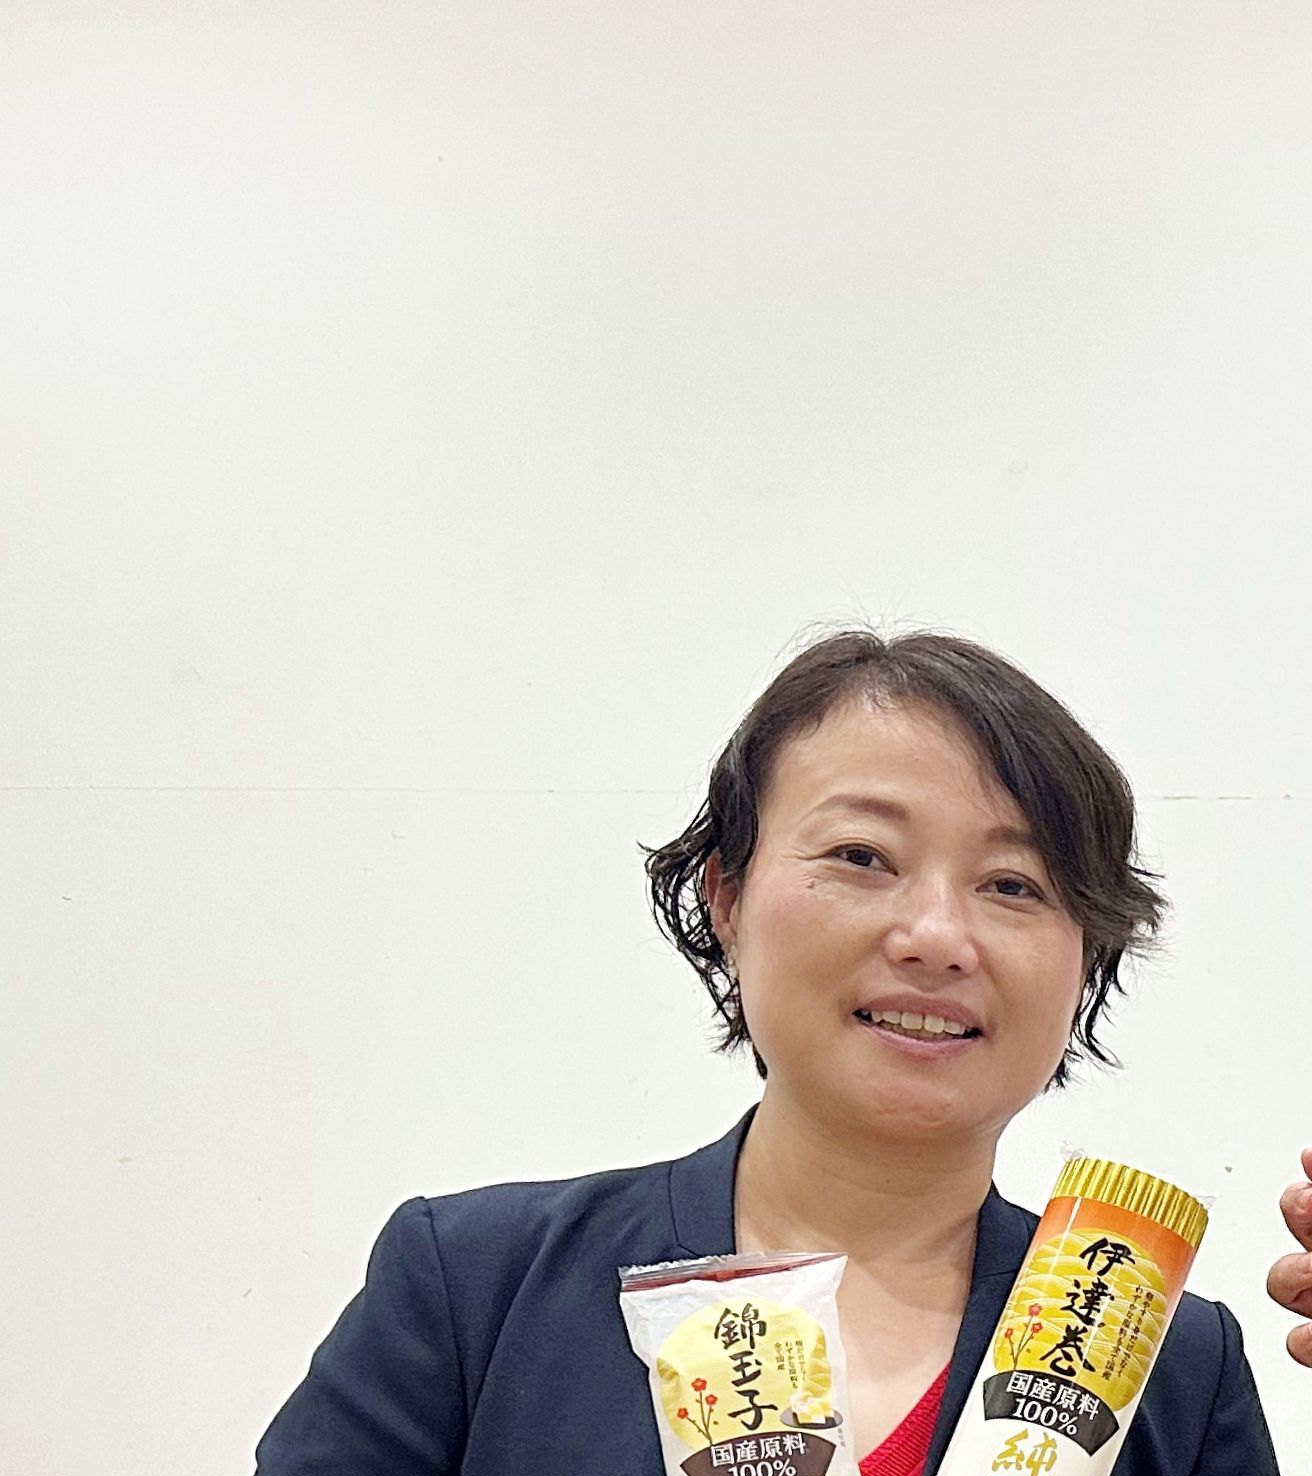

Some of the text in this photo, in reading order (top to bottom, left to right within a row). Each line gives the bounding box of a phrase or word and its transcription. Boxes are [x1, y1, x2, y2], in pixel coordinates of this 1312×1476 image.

[1040, 1237, 1136, 1377] 伊達巻
[714, 1303, 779, 1431] 錦玉子
[1006, 1371, 1100, 1421] 国産原料
[1012, 1398, 1079, 1436] 100%
[711, 1433, 807, 1468] 国産原料
